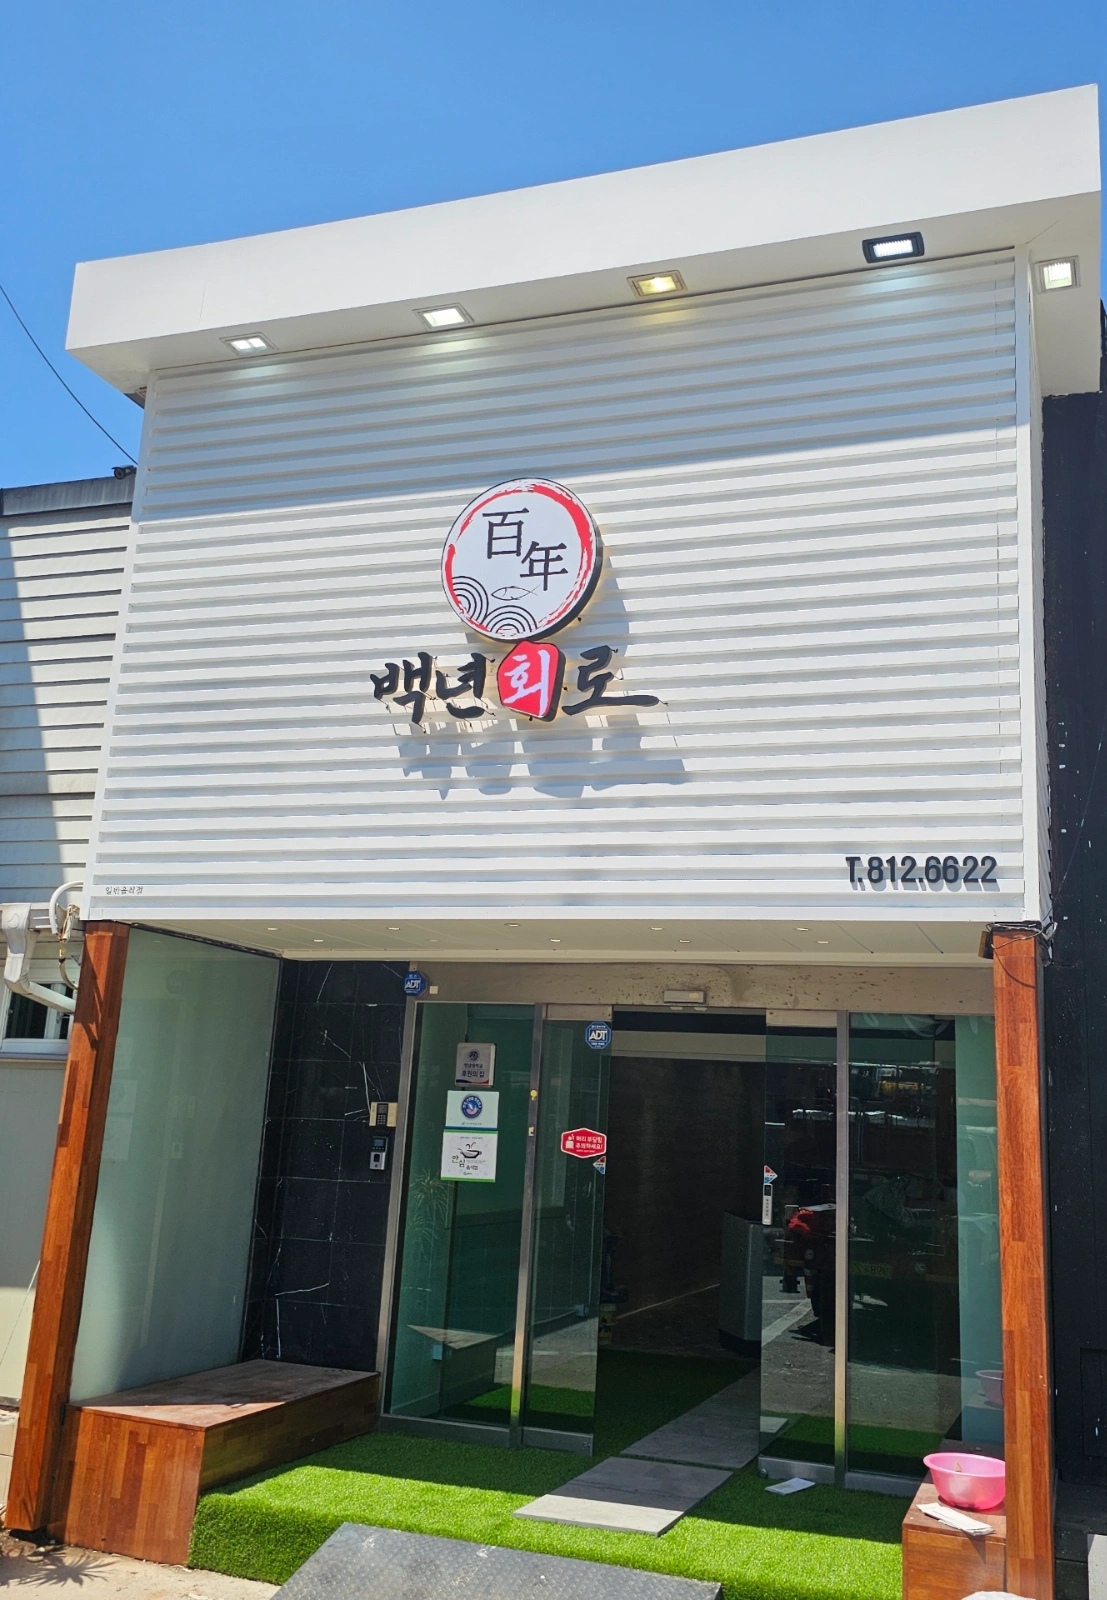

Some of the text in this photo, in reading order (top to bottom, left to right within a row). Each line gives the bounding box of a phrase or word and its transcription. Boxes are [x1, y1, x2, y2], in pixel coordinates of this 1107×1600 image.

[482, 507, 568, 591] 百年
[370, 645, 660, 724] 백년회로
[845, 855, 997, 884] T.812.6622
[404, 980, 420, 988] ADT
[589, 1030, 607, 1041] ADT
